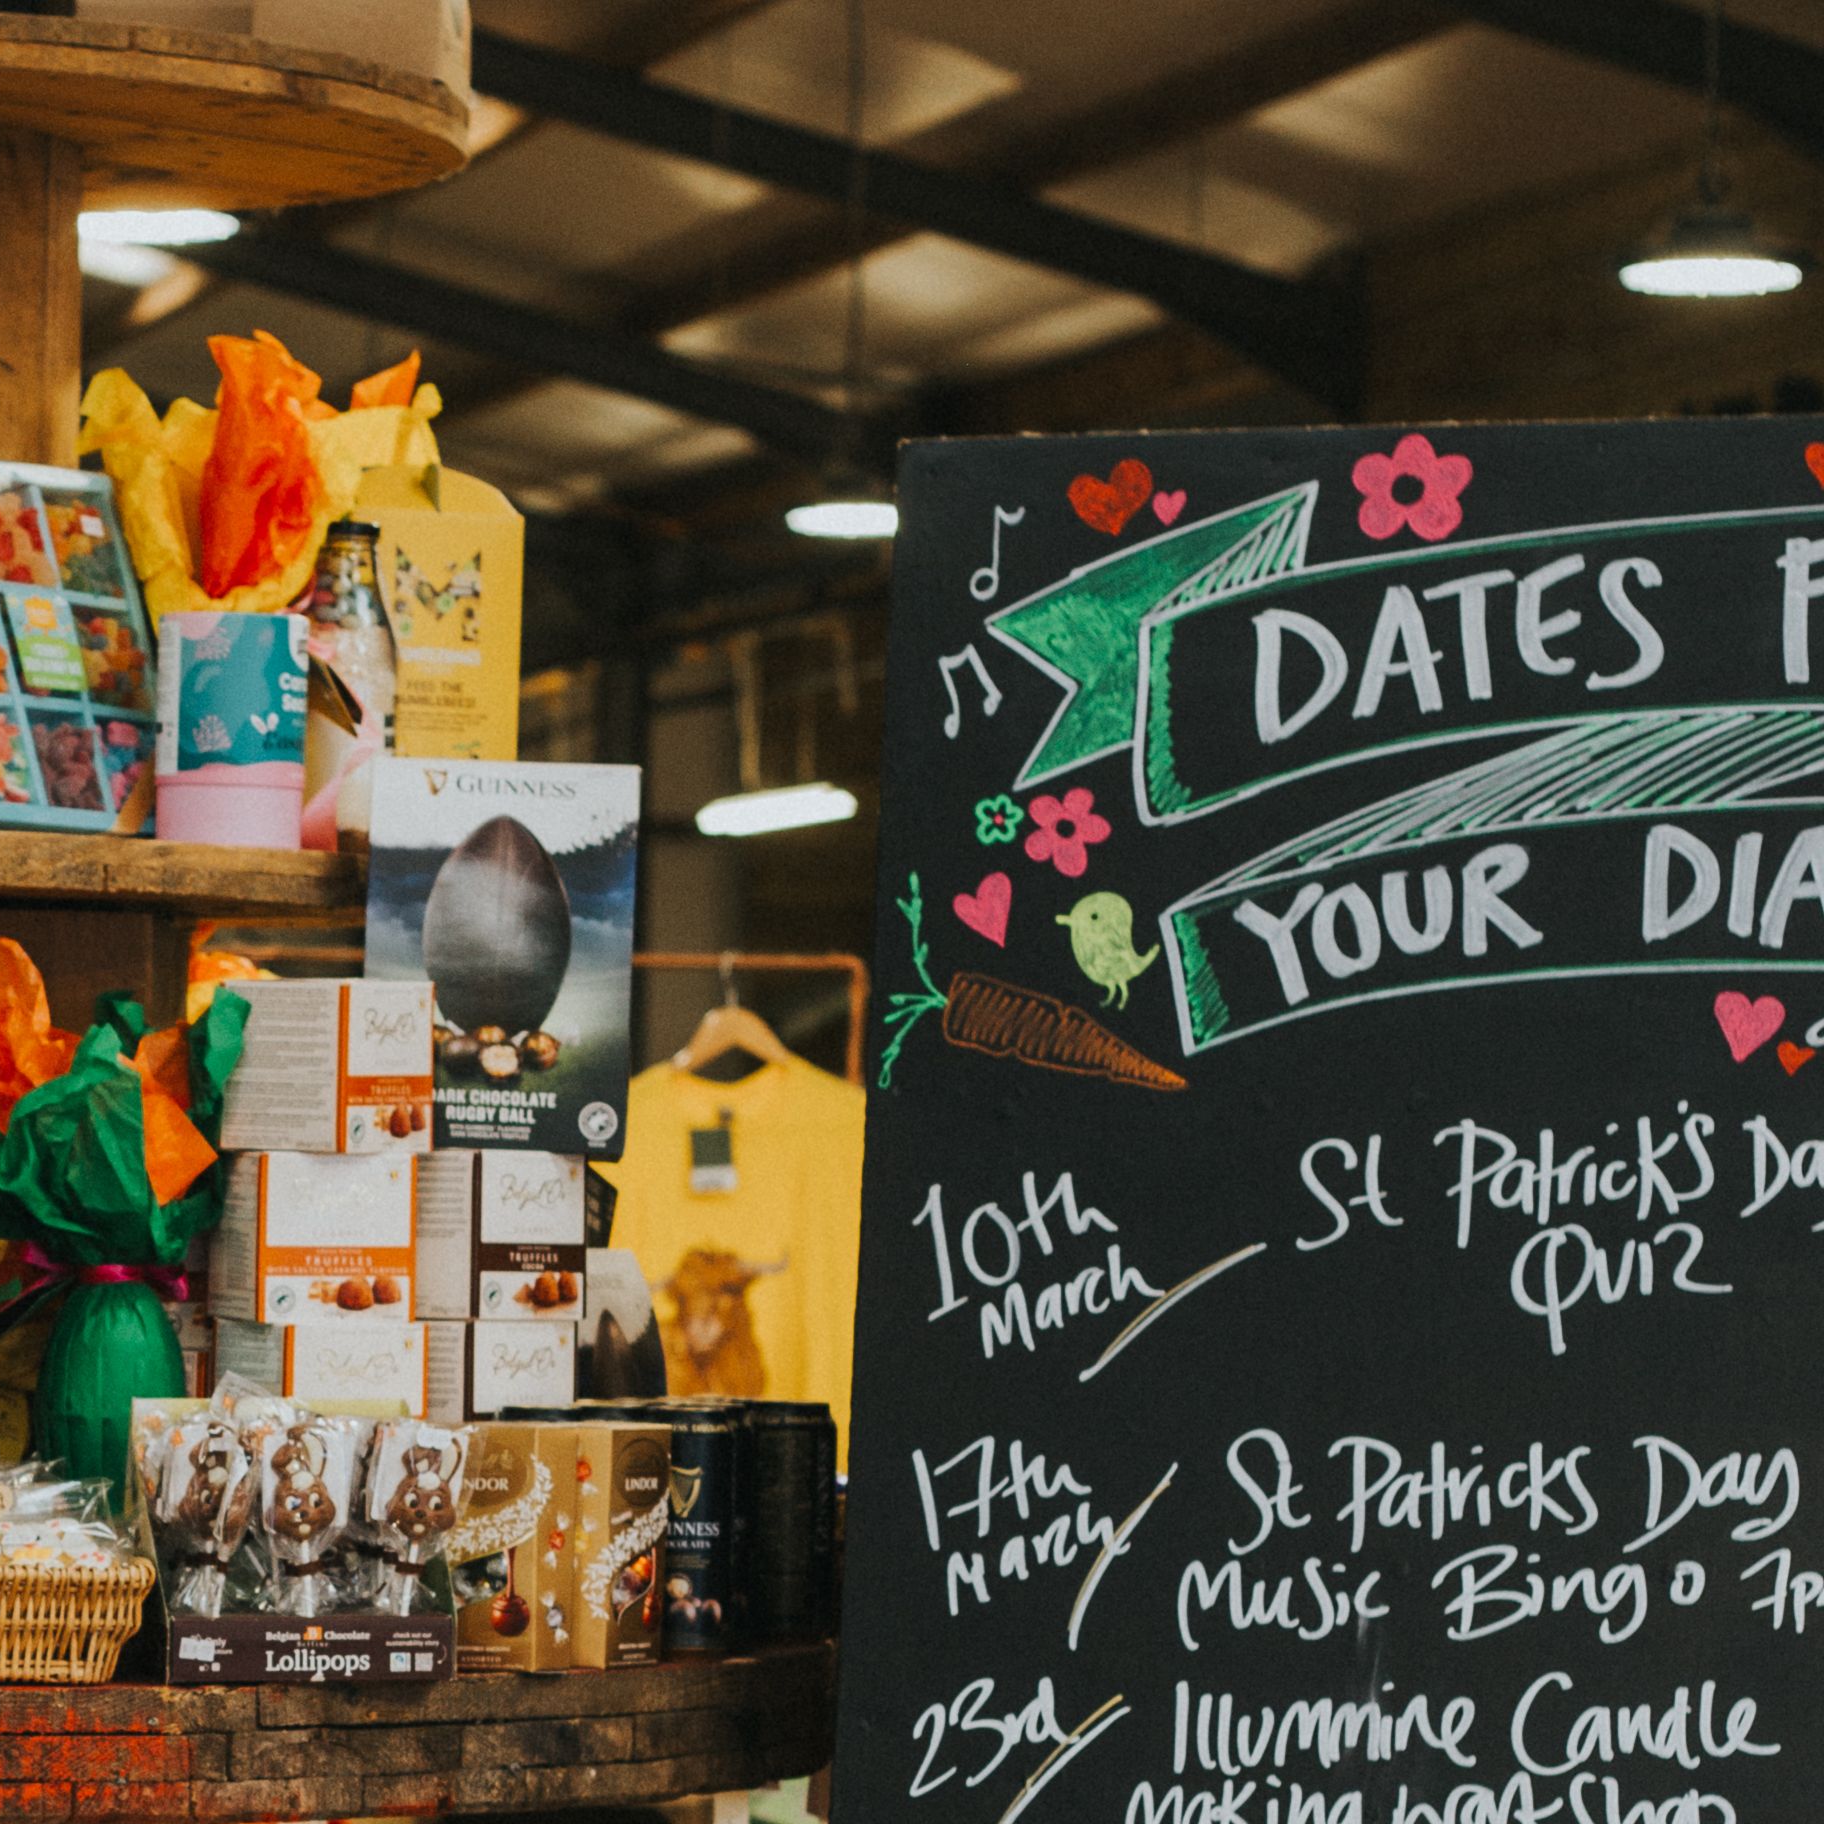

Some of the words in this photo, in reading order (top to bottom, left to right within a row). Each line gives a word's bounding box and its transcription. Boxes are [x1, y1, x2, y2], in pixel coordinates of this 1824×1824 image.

[1254, 555, 1666, 745] DATES
[457, 774, 577, 797] GUINNESS
[1234, 844, 1543, 1005] YOUR
[445, 1105, 496, 1123] RUGBY
[499, 1106, 536, 1124] BALL
[469, 1089, 557, 1109] CHOCOLATE
[1297, 1135, 1403, 1251] St
[305, 1254, 373, 1267] TRUFFLES
[509, 1251, 559, 1264] TRUFFLES
[913, 1171, 1119, 1322] 10th
[983, 1244, 1168, 1358] March
[462, 1477, 509, 1492] NDOR
[624, 1476, 659, 1492] LINDOR
[913, 1435, 1091, 1551] 17th
[1227, 1427, 1311, 1555] St
[1328, 1436, 1600, 1553] Patricks
[1622, 1435, 1801, 1553] Day
[667, 1521, 721, 1537] INNESS
[1176, 1556, 1390, 1650] Music
[1432, 1543, 1708, 1645] Bingo
[266, 1630, 301, 1643] Belgian
[324, 1630, 371, 1641] Chocolate
[266, 1650, 371, 1678] Lollipops
[909, 1675, 1081, 1798] 23rd
[1511, 1671, 1782, 1776] Candle
